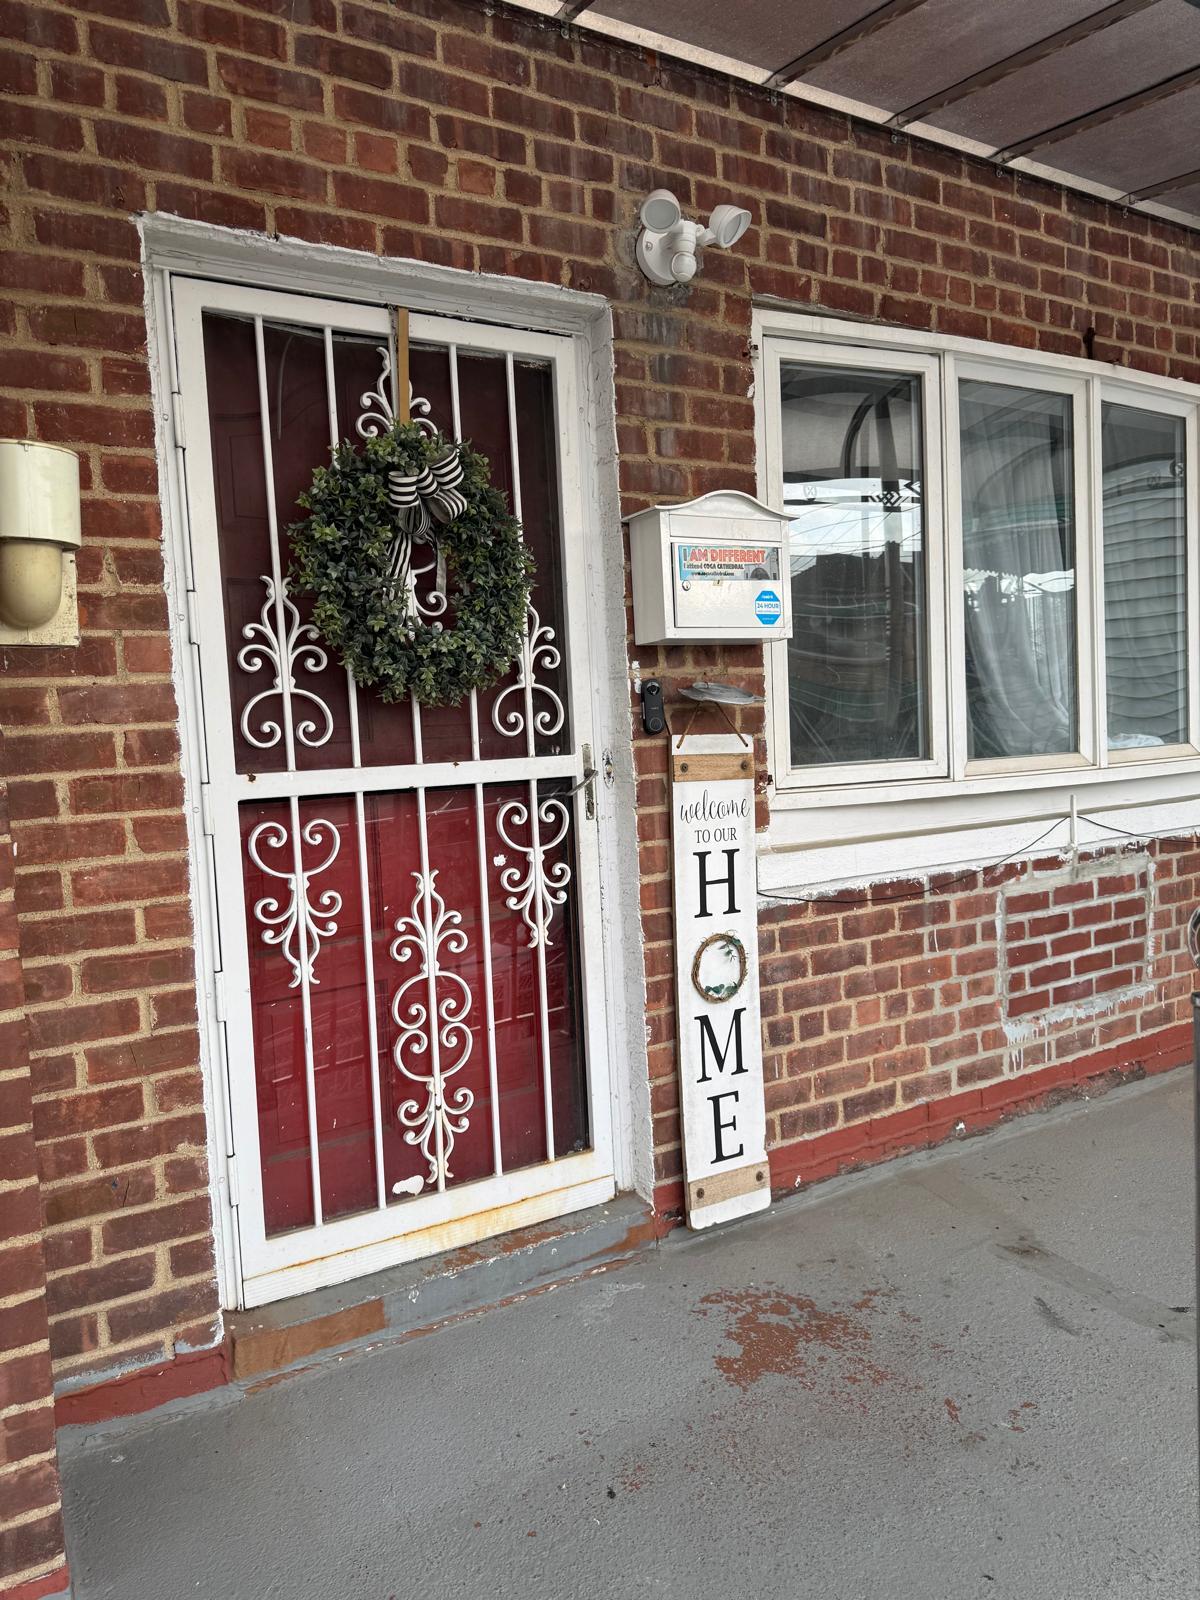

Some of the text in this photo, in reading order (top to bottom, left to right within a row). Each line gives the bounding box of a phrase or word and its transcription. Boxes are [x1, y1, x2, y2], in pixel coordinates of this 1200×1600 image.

[683, 548, 766, 563] I AM DIFFERENT
[680, 789, 750, 824] welcome
[694, 827, 738, 844] TO OUR
